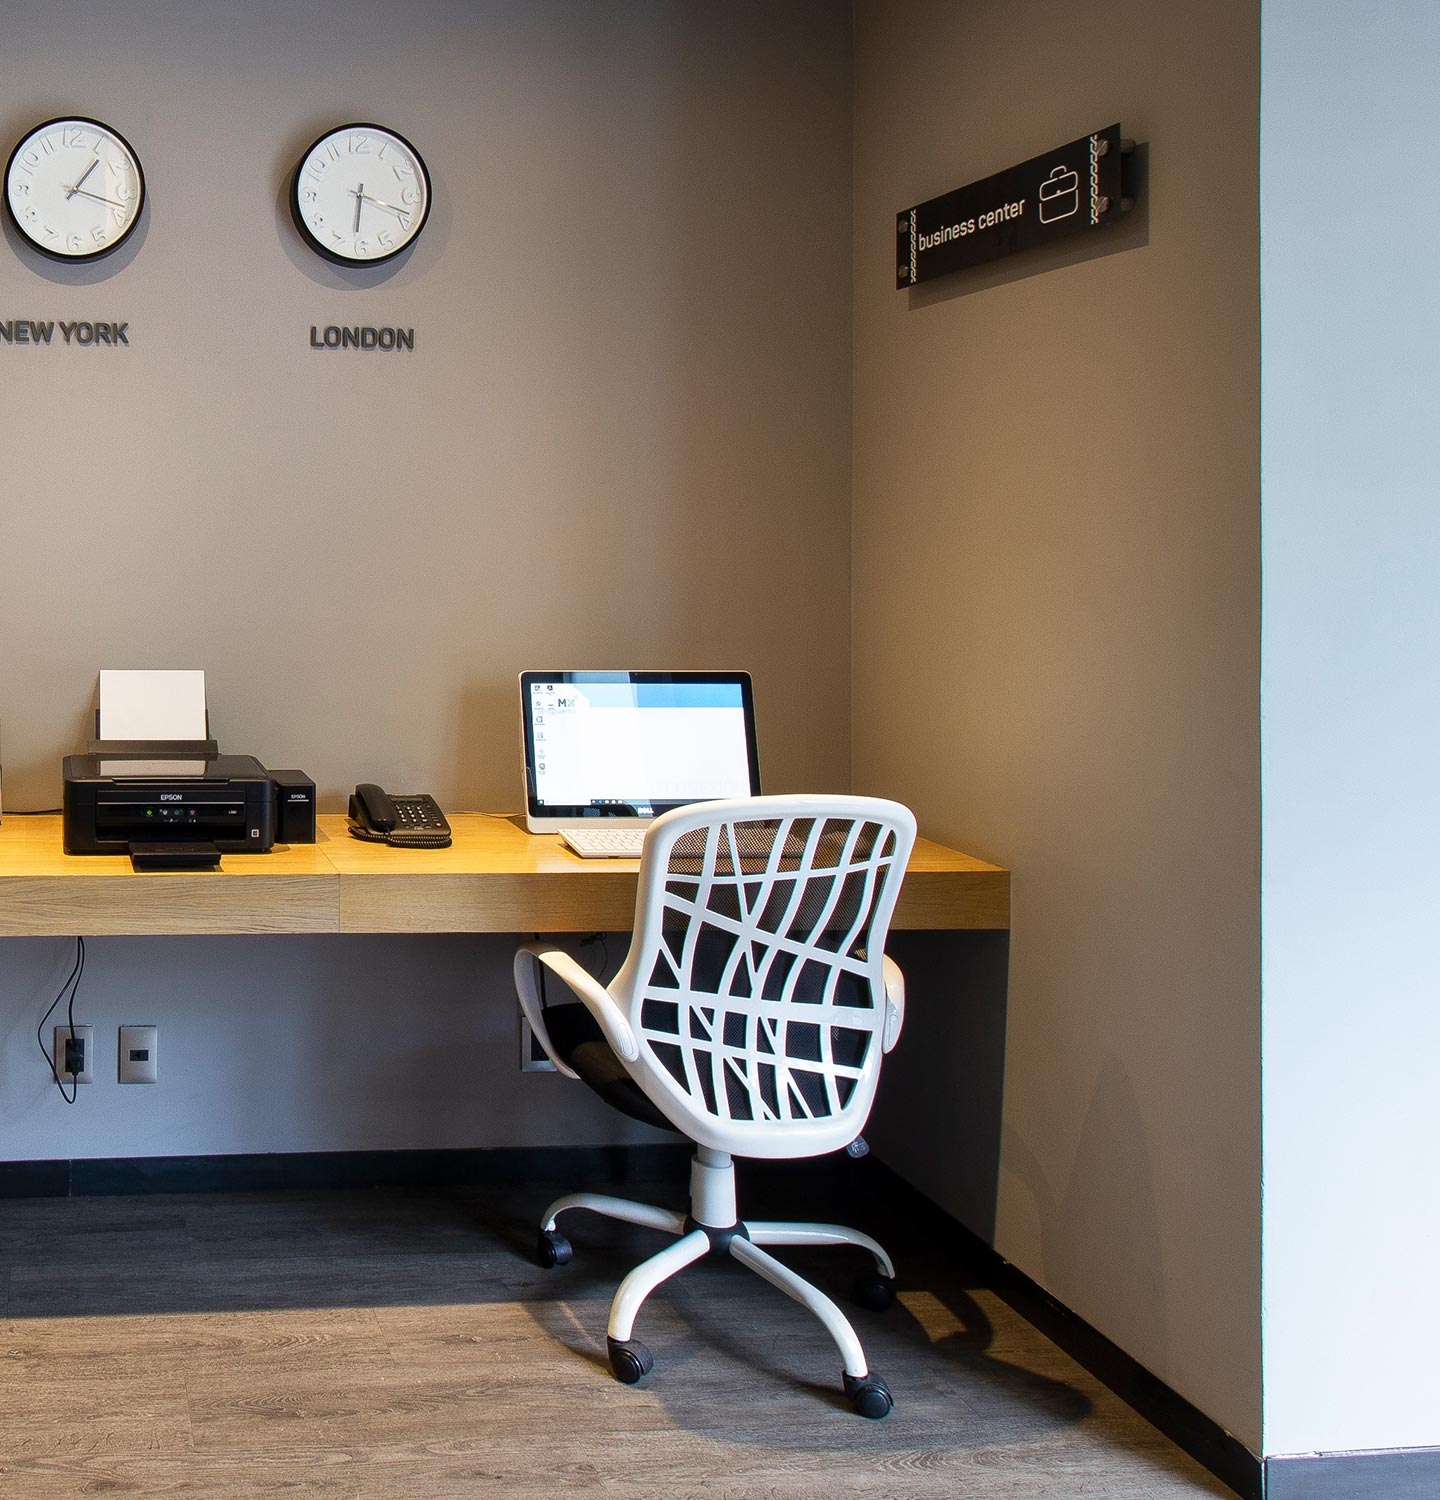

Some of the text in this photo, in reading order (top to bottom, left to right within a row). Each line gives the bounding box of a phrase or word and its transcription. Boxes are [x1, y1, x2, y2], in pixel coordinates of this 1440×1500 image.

[39, 133, 56, 155] 11
[62, 127, 86, 148] 12
[348, 133, 372, 154] 12
[325, 140, 341, 161] 11
[16, 147, 41, 176] 10
[108, 153, 131, 177] 2
[307, 157, 329, 182] 10
[392, 159, 414, 182] 2
[42, 225, 59, 240] 7
[919, 199, 1025, 251] business center
[66, 232, 82, 253] 6
[91, 226, 107, 247] 5
[330, 230, 346, 246] 7
[377, 231, 394, 251] 5
[353, 238, 369, 257] 6
[60, 321, 129, 345] YORK
[310, 326, 415, 350] LONDON
